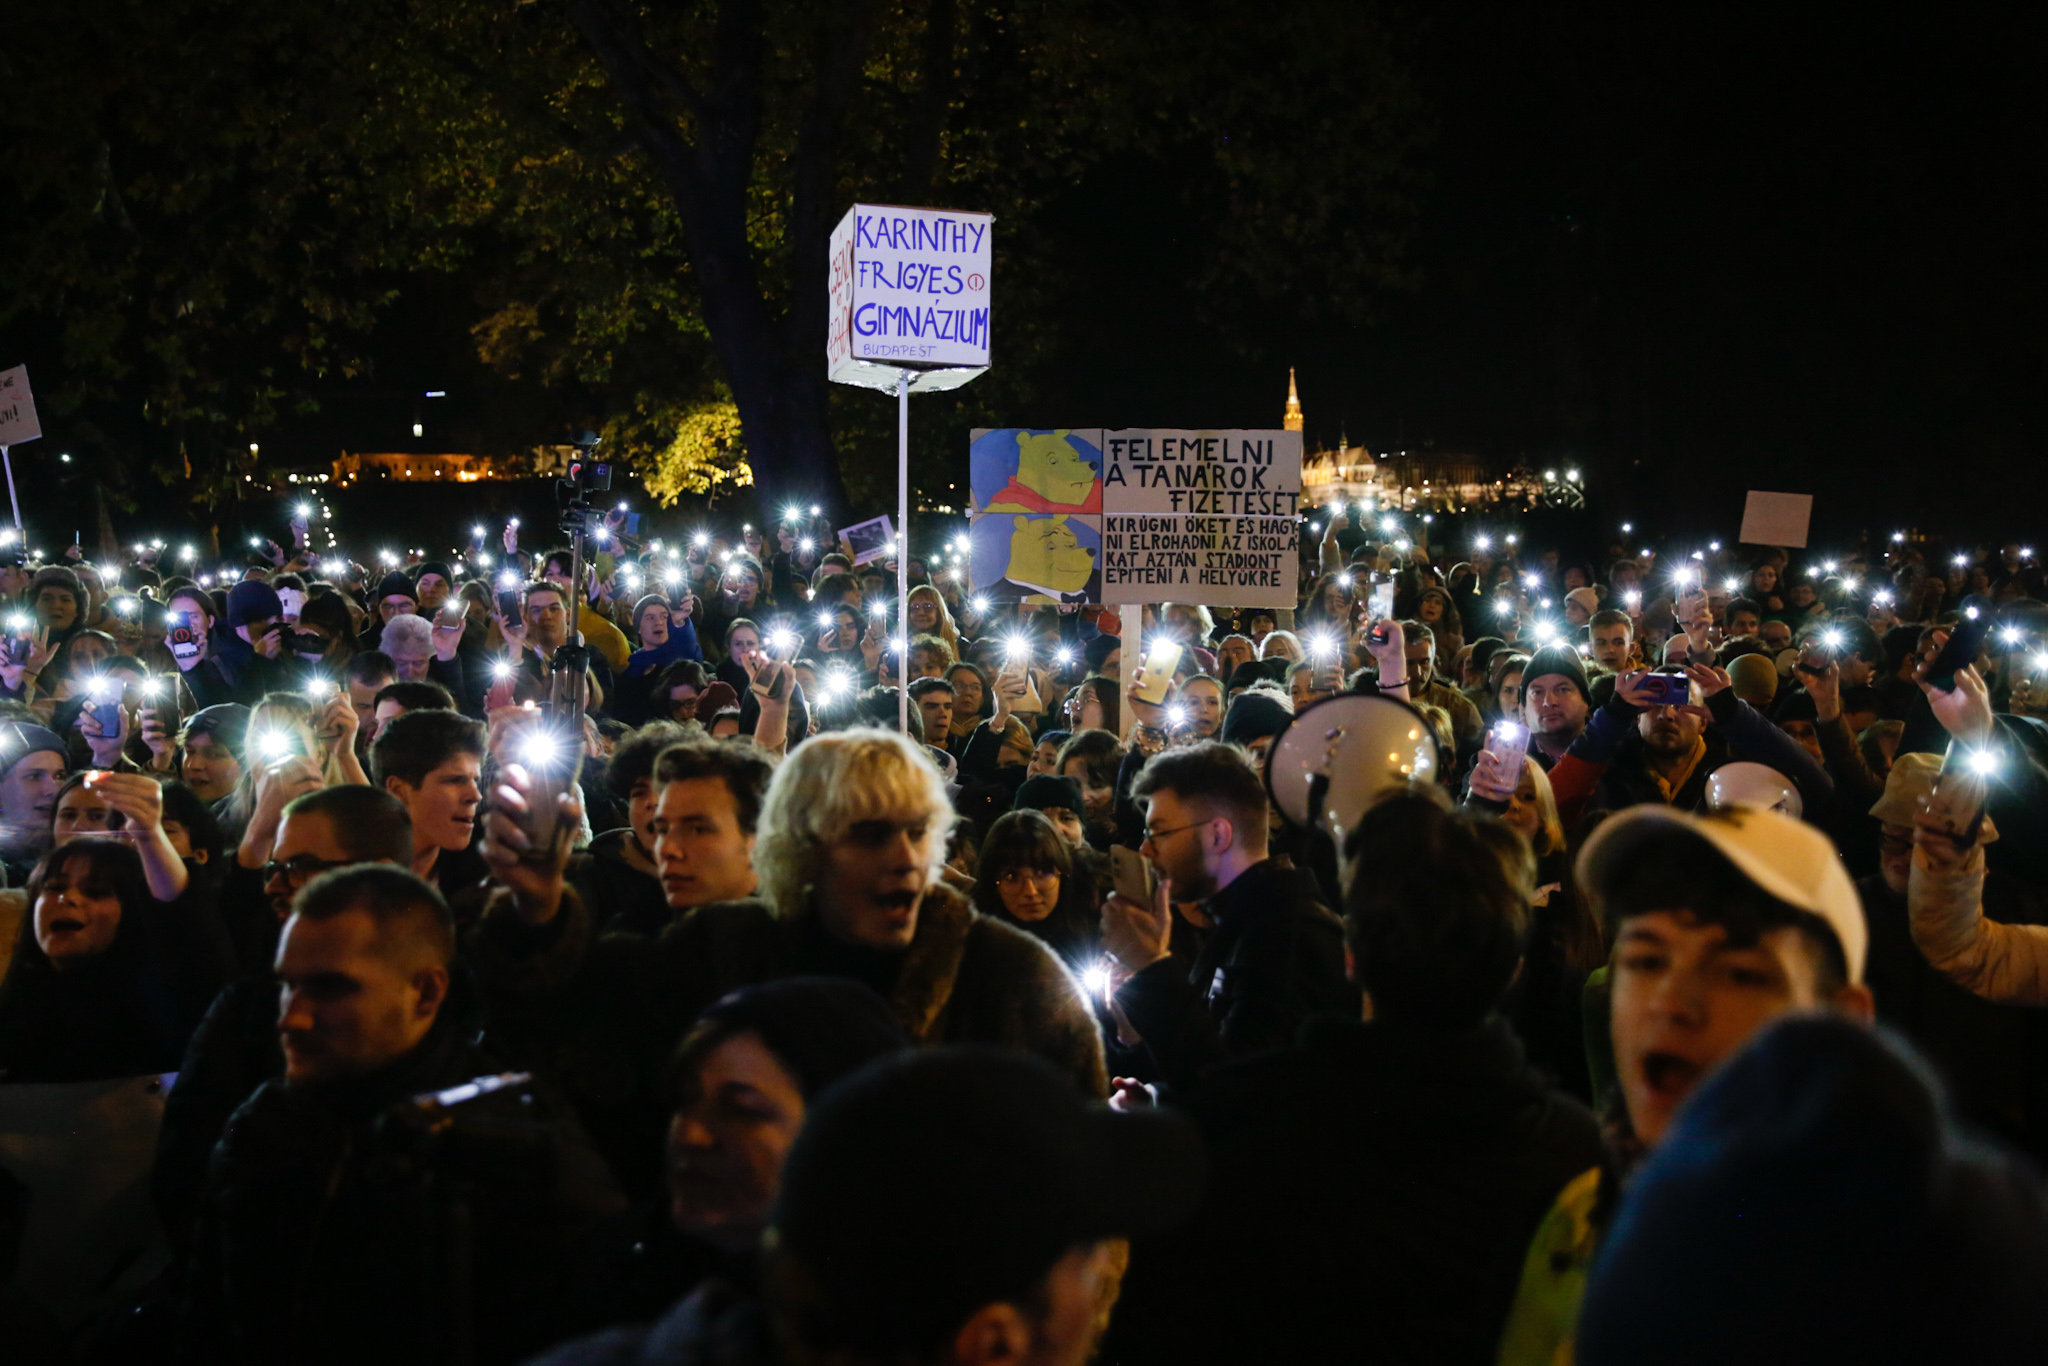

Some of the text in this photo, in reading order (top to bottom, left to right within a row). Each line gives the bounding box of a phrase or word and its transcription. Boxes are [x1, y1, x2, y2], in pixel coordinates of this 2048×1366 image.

[856, 216, 985, 253] KARINTHY
[858, 261, 964, 295] FRIGYES
[854, 299, 989, 350] GIMNÁZIUM
[863, 343, 937, 358] BUDAPEST
[1109, 439, 1273, 465] FELEMELNI
[1105, 463, 1268, 490] A TANÁROK
[1169, 485, 1300, 516] FIZETÉSÉT
[1107, 516, 1177, 533] KIRÚGNI
[1236, 517, 1254, 534] ÉS
[1107, 535, 1122, 549] NI
[1130, 535, 1216, 549] ELROHADNI
[1222, 536, 1241, 550] AZ
[1106, 551, 1282, 568] KAT AZTÁN STADIONT
[1106, 568, 1281, 587] ÉPÍTENI A HELYÜKRE
